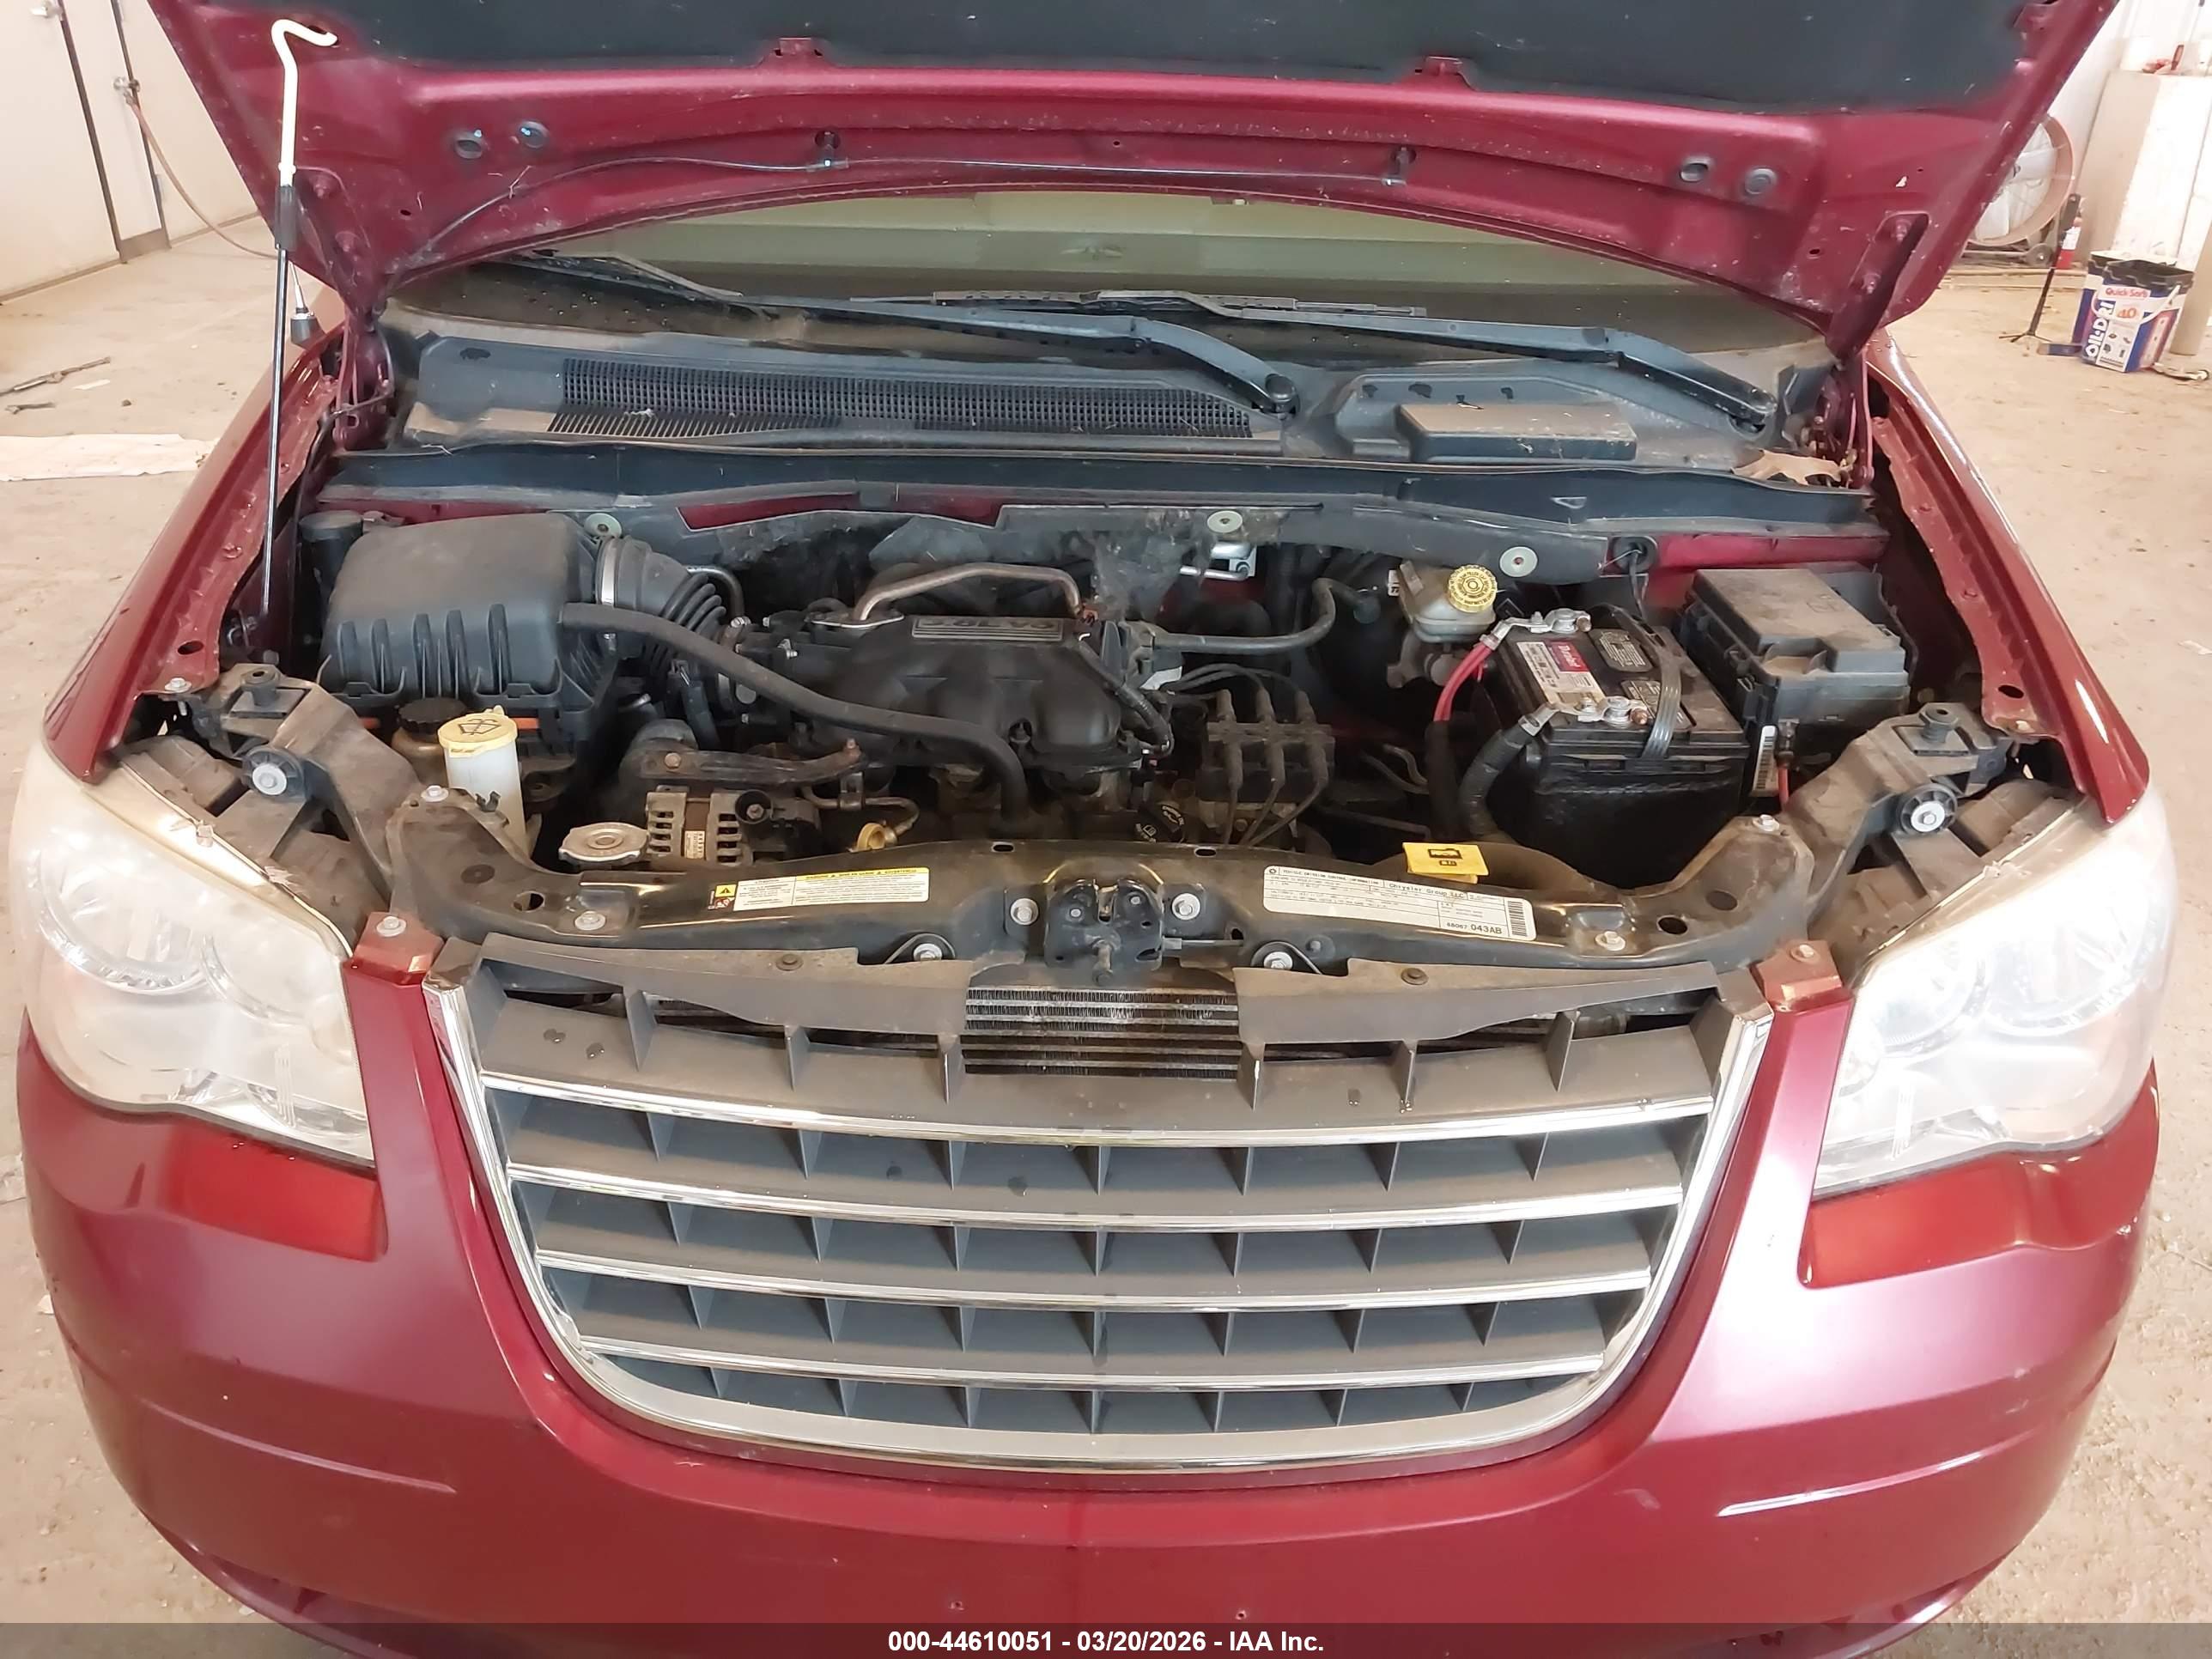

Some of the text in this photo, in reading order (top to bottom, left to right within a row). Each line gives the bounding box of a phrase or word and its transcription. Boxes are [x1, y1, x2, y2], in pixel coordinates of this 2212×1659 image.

[1389, 882, 1422, 892] Chrysler
[1426, 888, 1448, 897] Group
[1470, 923, 1503, 935] 043AB
